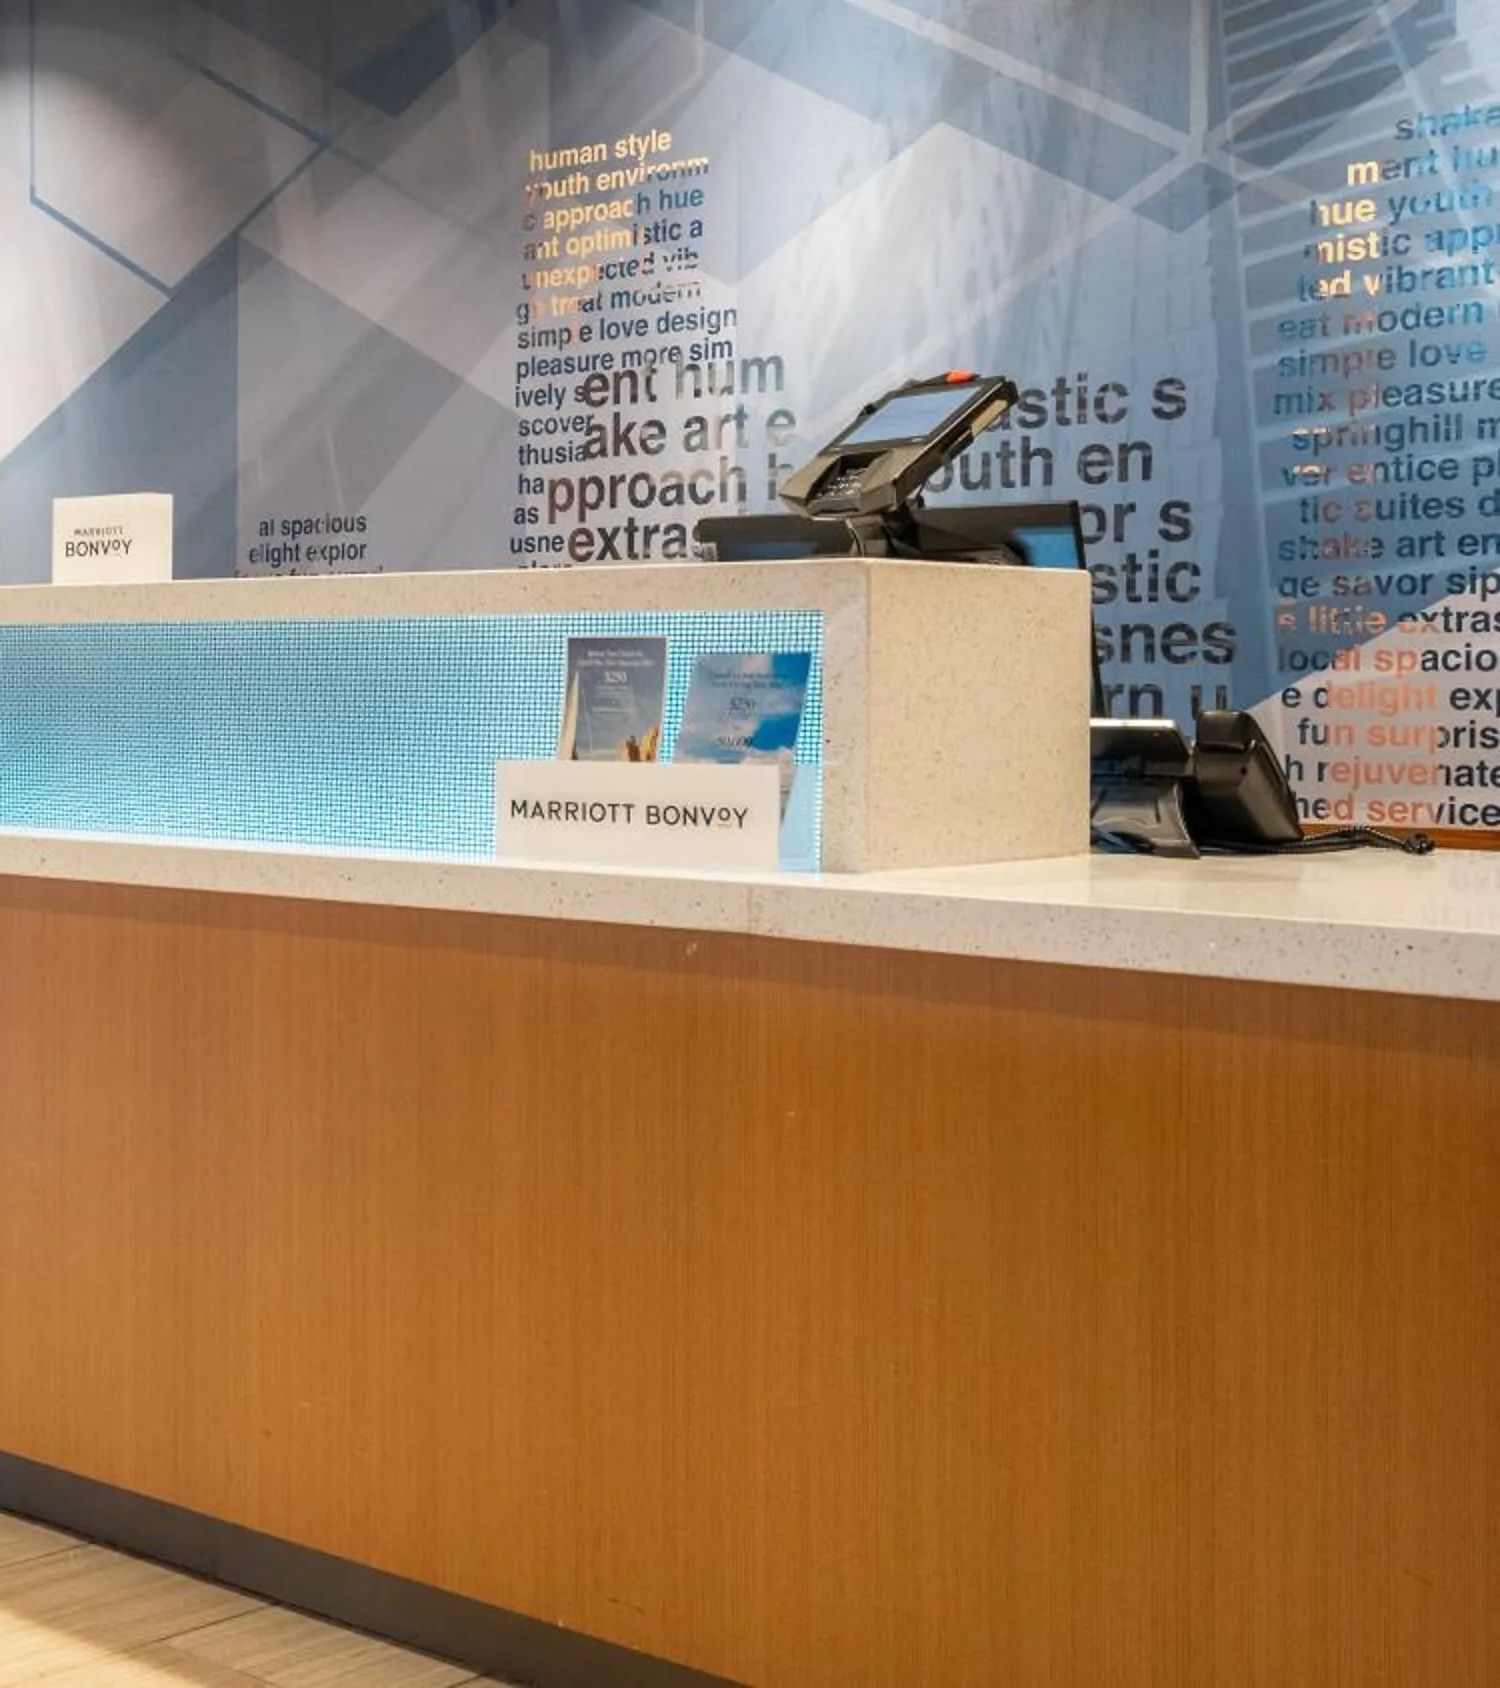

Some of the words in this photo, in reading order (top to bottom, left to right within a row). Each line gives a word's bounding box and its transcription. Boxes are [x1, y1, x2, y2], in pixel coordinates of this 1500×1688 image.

[530, 142, 606, 172] human
[615, 129, 672, 168] style
[597, 156, 709, 192] environm
[543, 190, 650, 233] approach
[659, 188, 705, 212] hue
[1309, 198, 1376, 227] hue
[566, 218, 682, 259] optimistic
[689, 219, 703, 238] a
[1363, 259, 1495, 297] vibrant
[600, 312, 649, 340] love
[657, 308, 738, 335] design
[1343, 299, 1484, 336] modern
[516, 351, 614, 384] pleasure
[689, 338, 733, 362] sim
[583, 364, 658, 408] ent
[987, 372, 1129, 433] stic
[1152, 376, 1189, 421] s
[1274, 386, 1336, 415] mix
[584, 412, 667, 459] ake
[682, 403, 750, 452] art
[1291, 413, 1463, 456] springhill
[1077, 438, 1154, 486] en
[1348, 454, 1459, 484] entice
[548, 455, 747, 525] pproach
[1300, 496, 1341, 524] tic
[1353, 492, 1465, 522] suites
[281, 514, 367, 540] spacious
[514, 504, 539, 525] as
[1158, 499, 1193, 543] s
[64, 539, 133, 558] BONVOY
[1396, 531, 1446, 557] art
[1091, 549, 1202, 603] stic
[1332, 572, 1434, 597] savor
[1278, 644, 1361, 673] local
[1374, 643, 1497, 678] spacio
[1281, 685, 1301, 708] e
[1314, 680, 1438, 716] delight
[1298, 716, 1354, 745] fun
[1367, 719, 1500, 754] surpris
[1285, 754, 1303, 782] h
[510, 799, 635, 826] MARRIOTT
[645, 804, 749, 830] BONVOY
